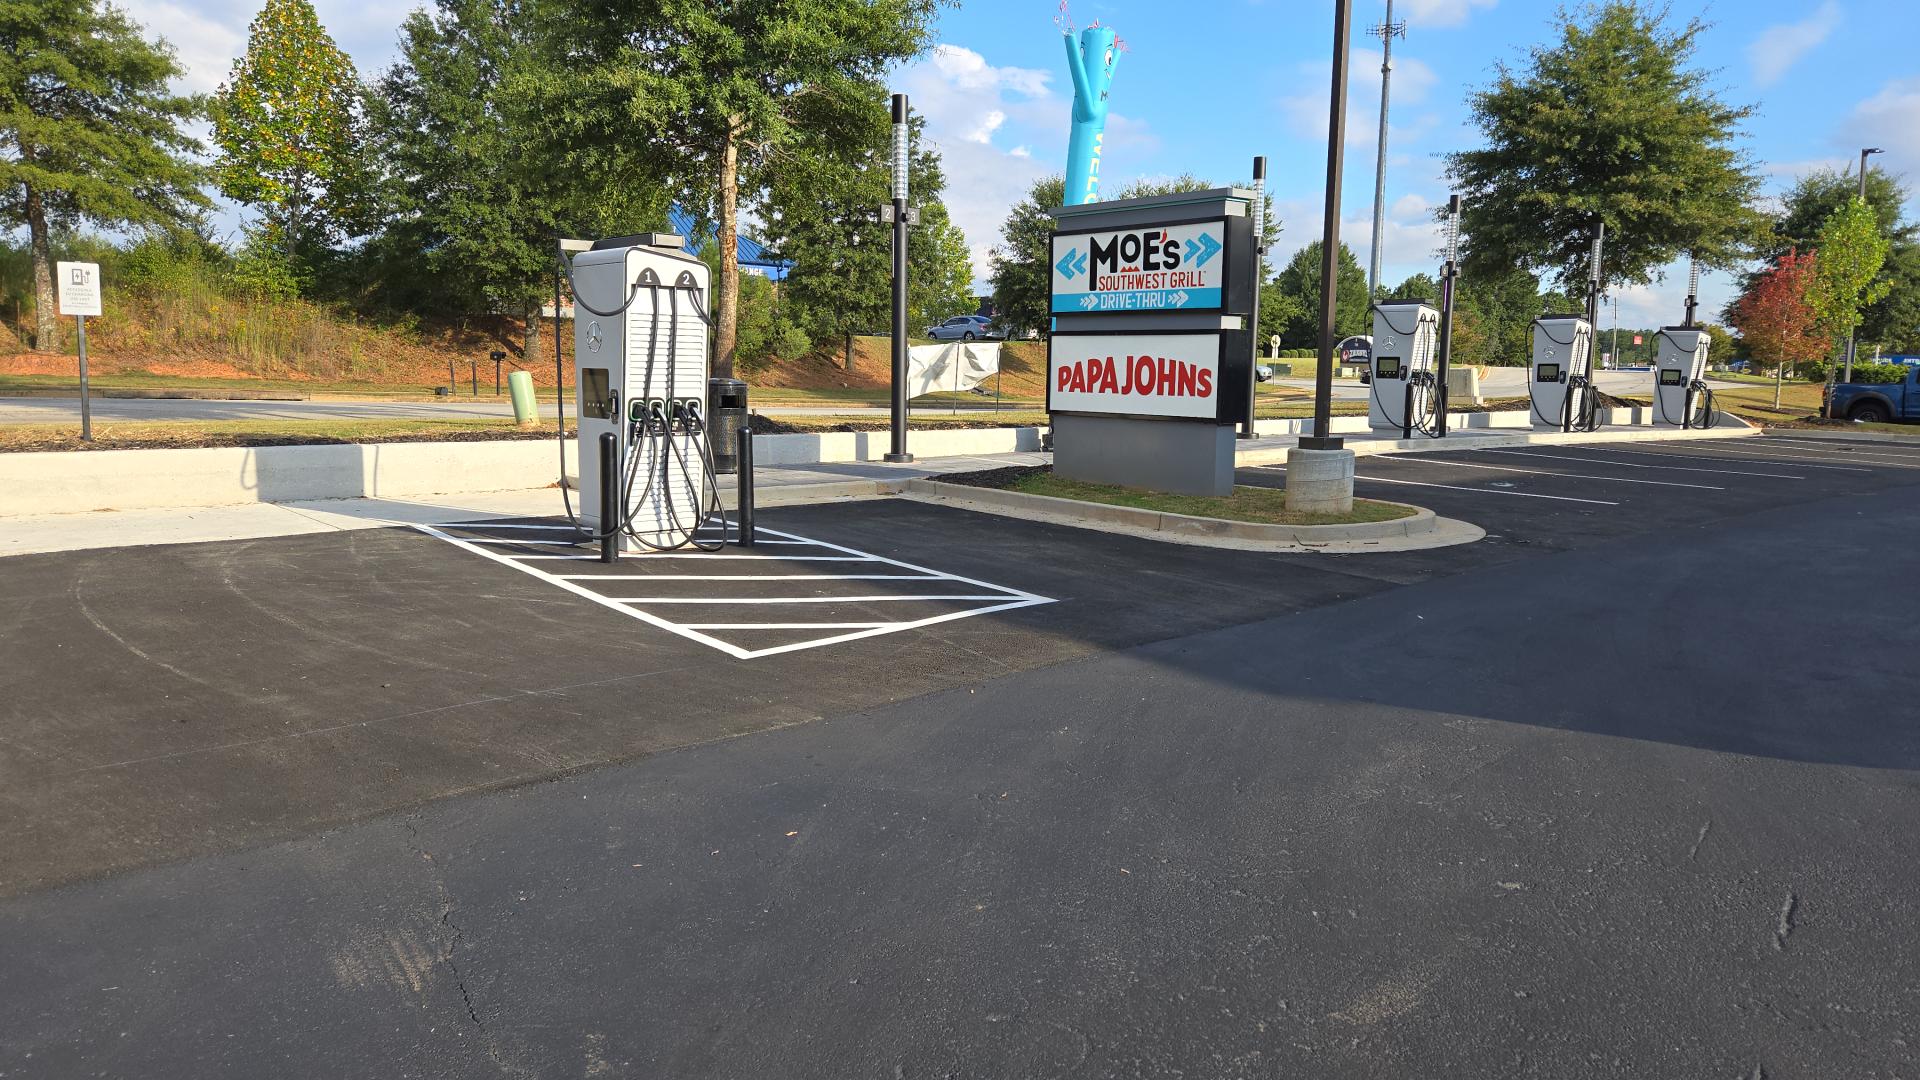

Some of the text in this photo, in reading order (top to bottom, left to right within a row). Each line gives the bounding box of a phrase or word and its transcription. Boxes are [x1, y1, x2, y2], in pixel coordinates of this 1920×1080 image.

[885, 208, 891, 219] 2
[910, 211, 916, 222] 3
[645, 271, 652, 283] 1
[682, 273, 690, 285] 2
[1099, 272, 1167, 291] SOUTHWEST
[1058, 355, 1212, 398] PAPA JOHNS
